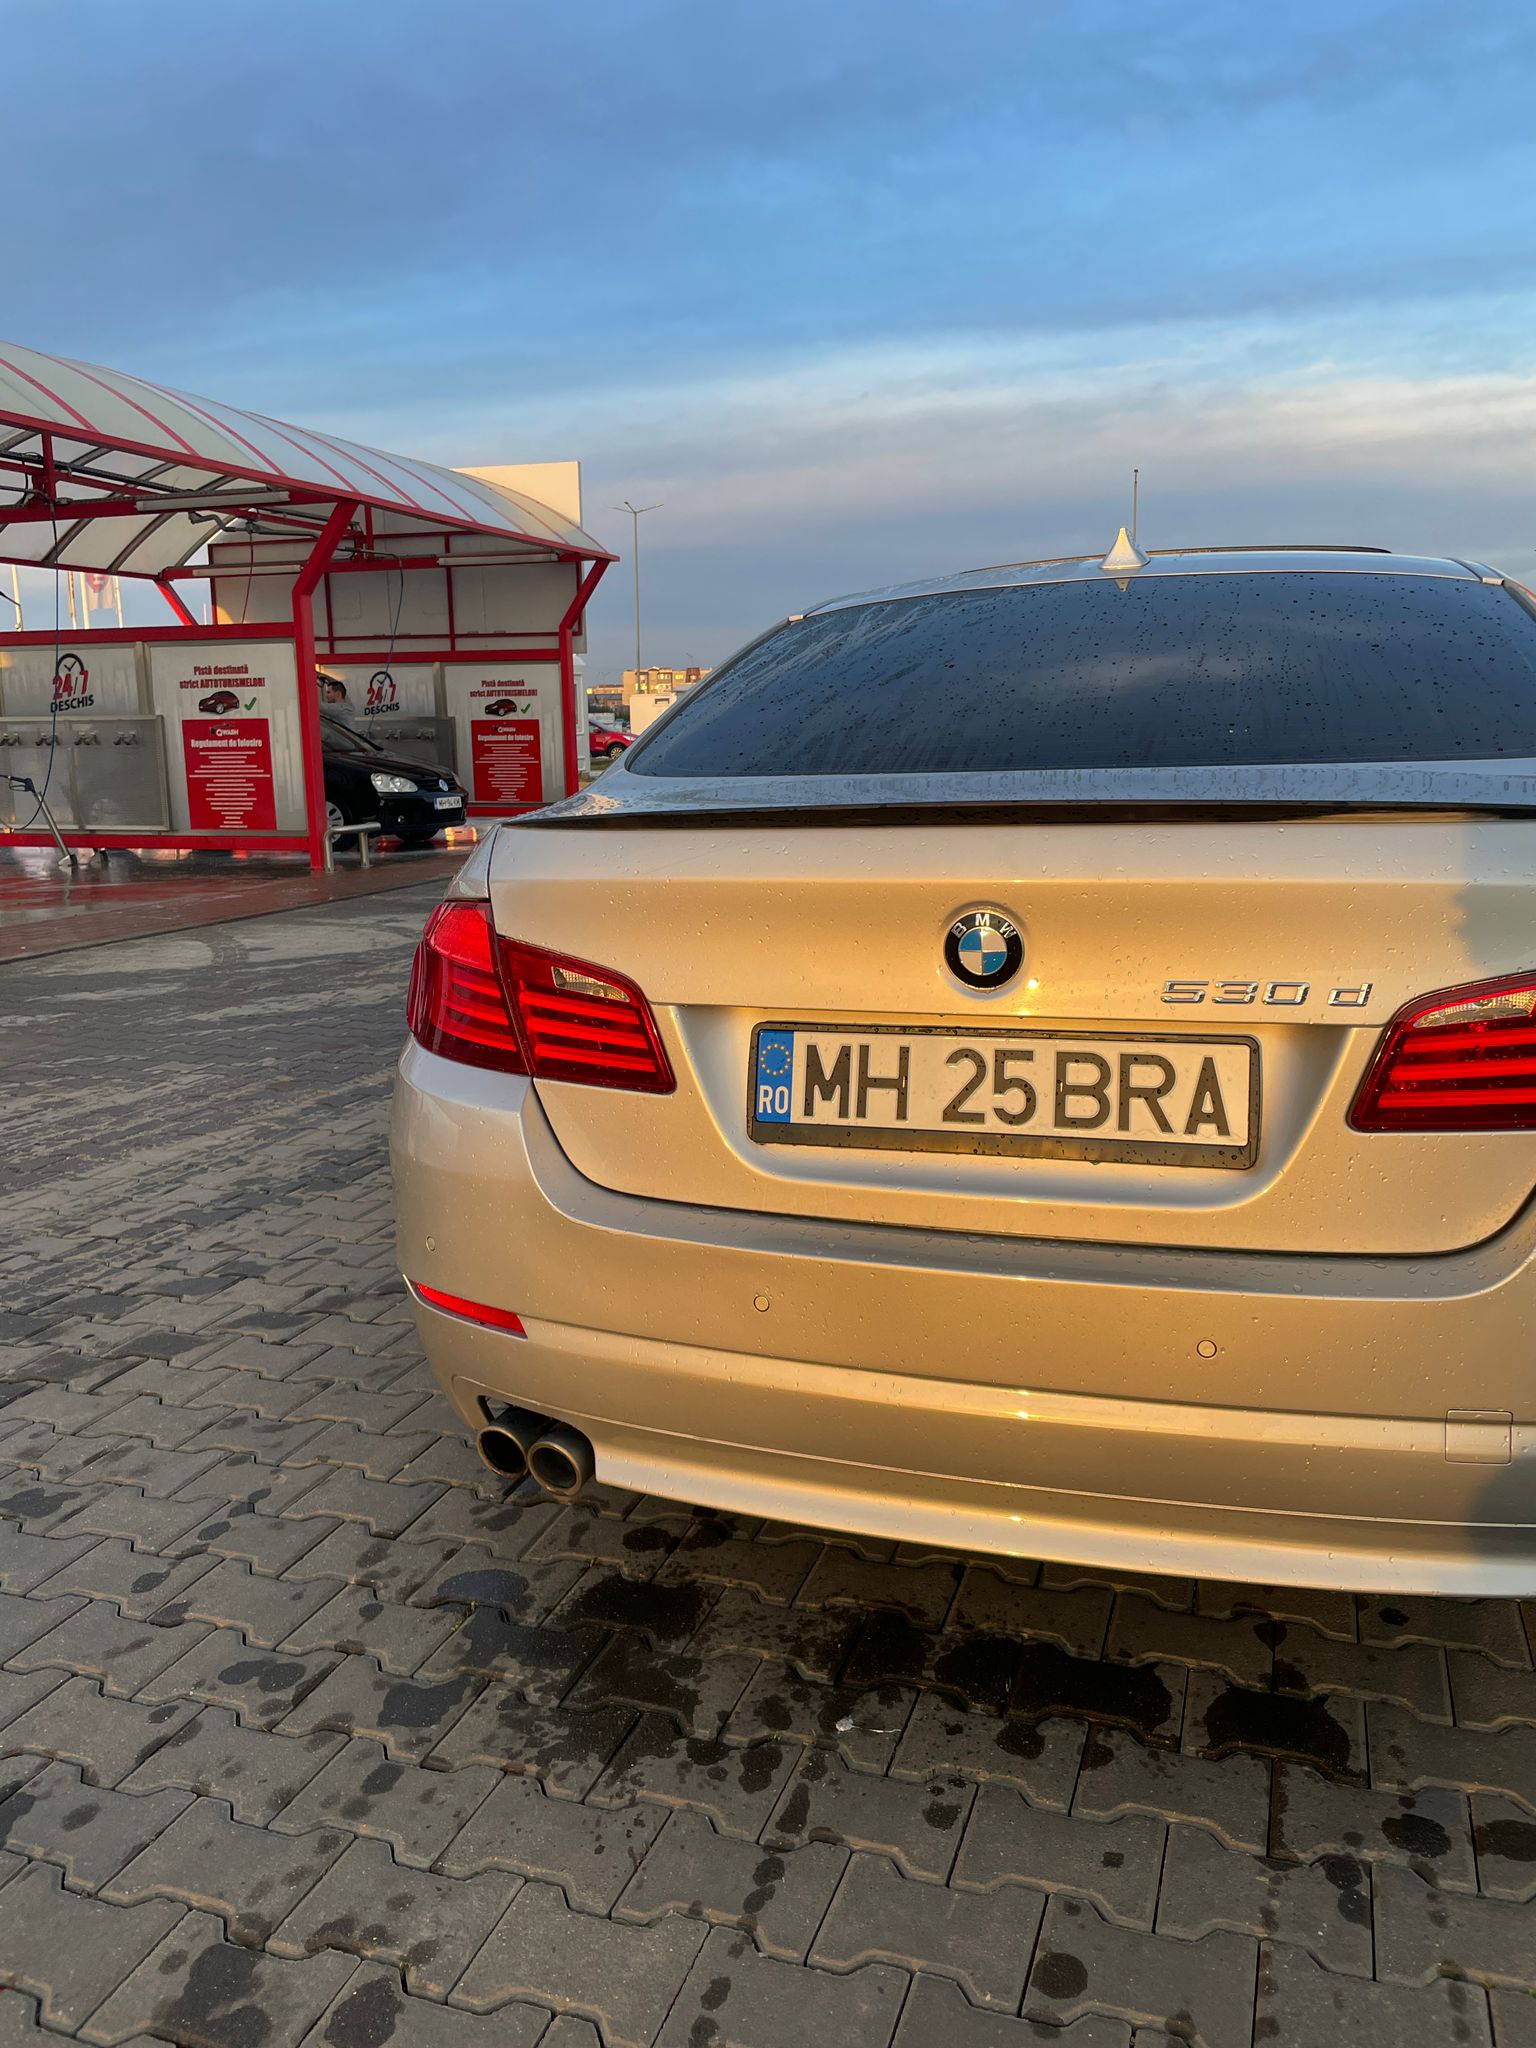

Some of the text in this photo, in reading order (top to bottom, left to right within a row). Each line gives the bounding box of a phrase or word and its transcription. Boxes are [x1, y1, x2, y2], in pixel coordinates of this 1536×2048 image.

[52, 670, 88, 700] 24/7
[367, 684, 396, 706] 24/7
[51, 695, 95, 713] DESCHIS
[364, 702, 400, 715] DESCHIS
[951, 913, 1017, 939] BMW
[1160, 980, 1373, 1007] 530 d
[758, 1085, 789, 1115] RO
[803, 1044, 1231, 1137] MH 25 BRA
